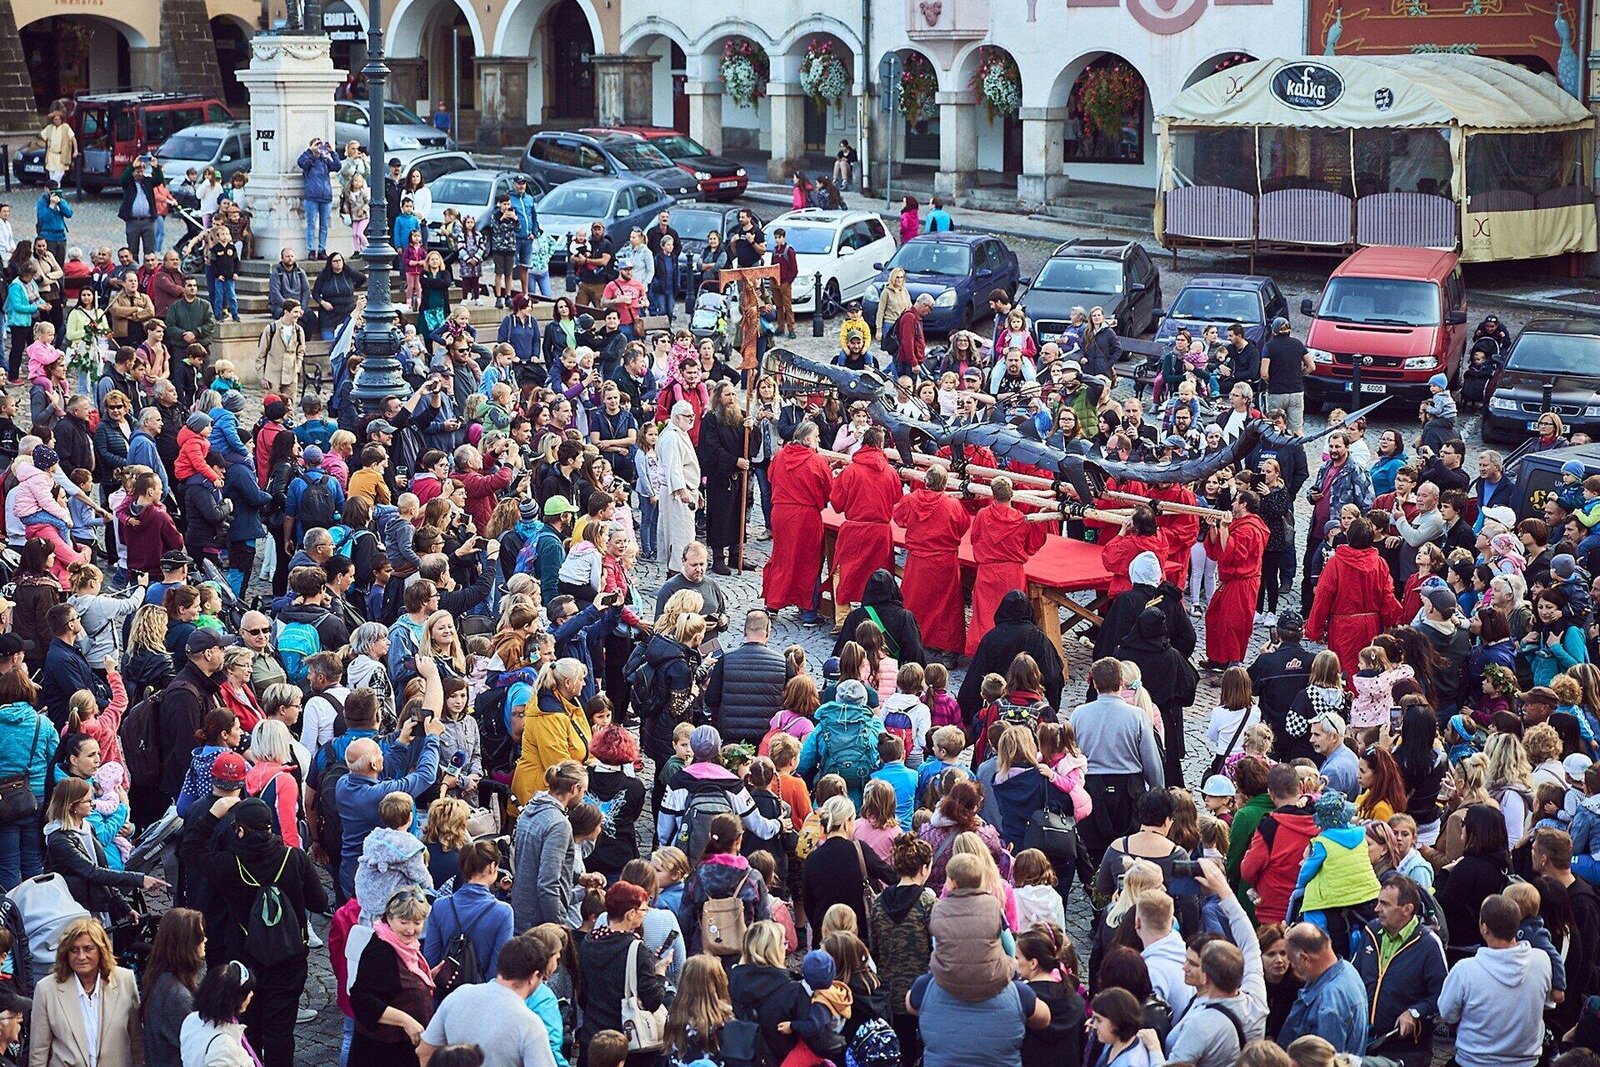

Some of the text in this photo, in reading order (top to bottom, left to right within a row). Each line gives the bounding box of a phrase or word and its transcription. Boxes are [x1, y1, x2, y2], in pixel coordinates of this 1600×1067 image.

[323, 12, 345, 26] GRAND
[1286, 66, 1326, 99] kafka
[255, 129, 275, 140] JOSEF
